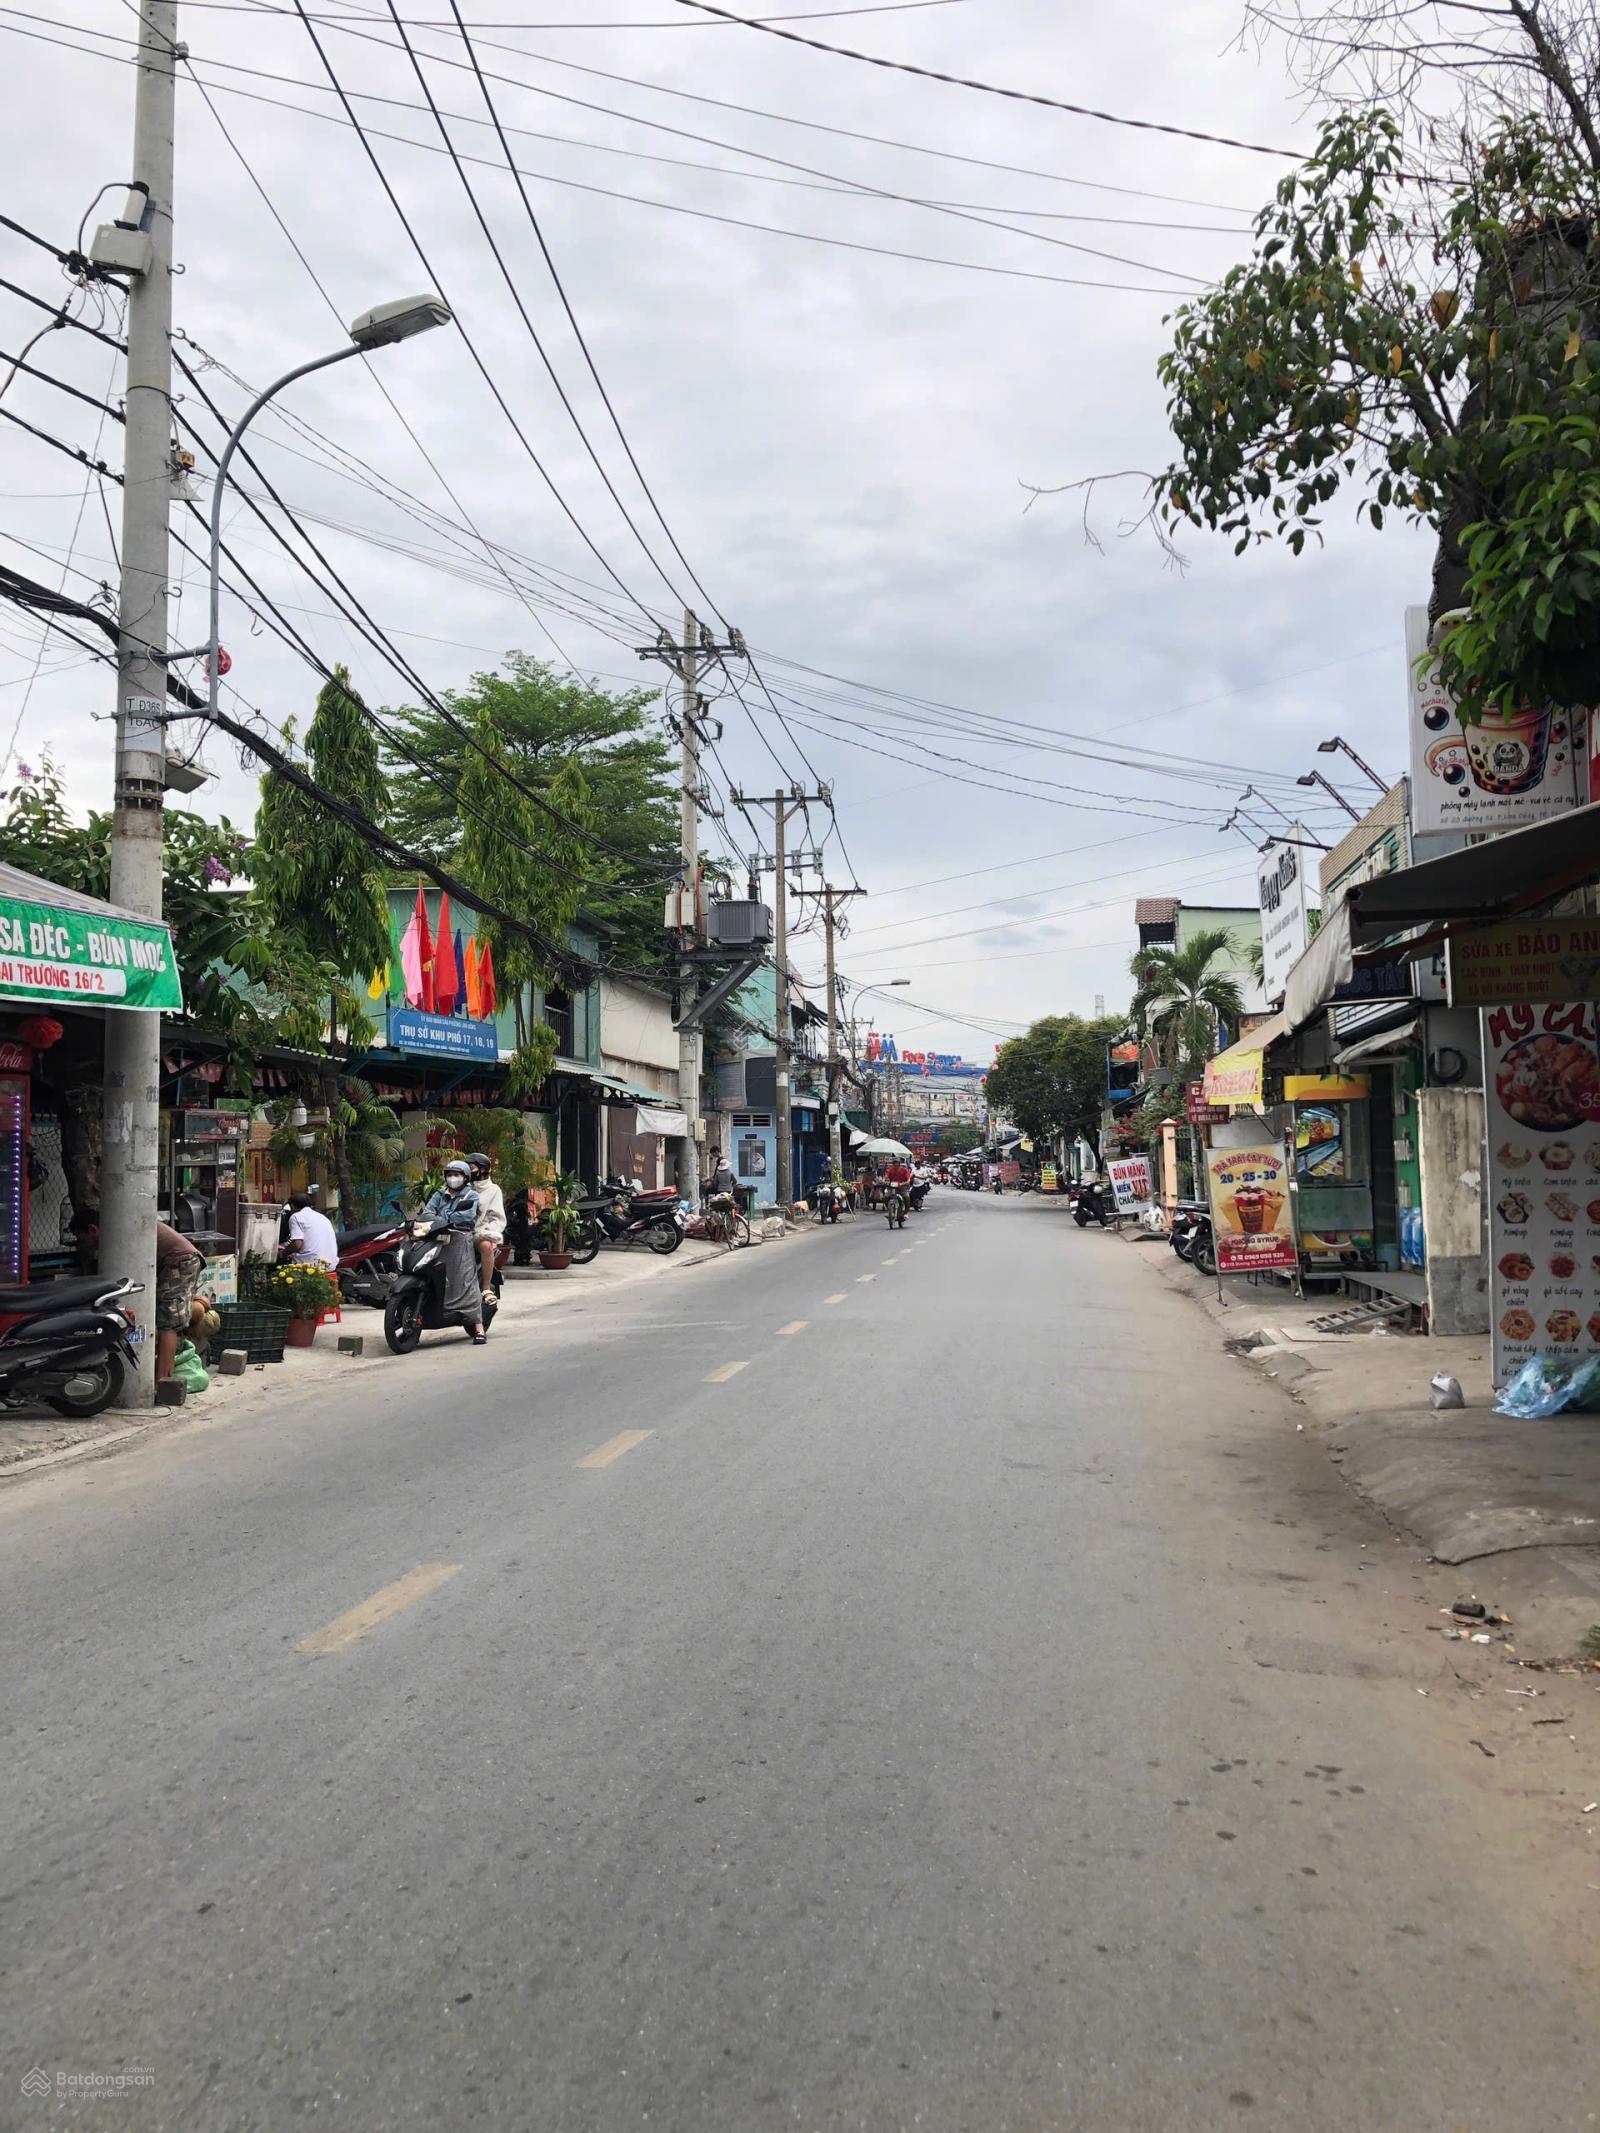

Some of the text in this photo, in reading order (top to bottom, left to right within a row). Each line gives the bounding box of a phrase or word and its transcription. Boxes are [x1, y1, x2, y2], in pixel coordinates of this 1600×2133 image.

[1493, 764, 1524, 774] PANDA
[1463, 798, 1478, 811] máy
[1480, 799, 1496, 808] lạnh
[87, 929, 128, 967] BÚN
[1495, 943, 1513, 957] XE
[1518, 927, 1561, 956] BẢO
[17, 963, 70, 988] TRƯƠNG
[75, 970, 105, 991] 16/2
[1375, 961, 1407, 992] TÂY
[399, 1024, 416, 1040] TRỤ
[417, 1025, 429, 1039] SỞ
[429, 1029, 446, 1042] KHU
[446, 1030, 462, 1044] PHỐ
[486, 1038, 494, 1049] 19
[1220, 1174, 1234, 1184] 20
[1242, 1172, 1256, 1182] 25
[1263, 1170, 1277, 1180] 30
[1257, 1236, 1279, 1244] SYRUP
